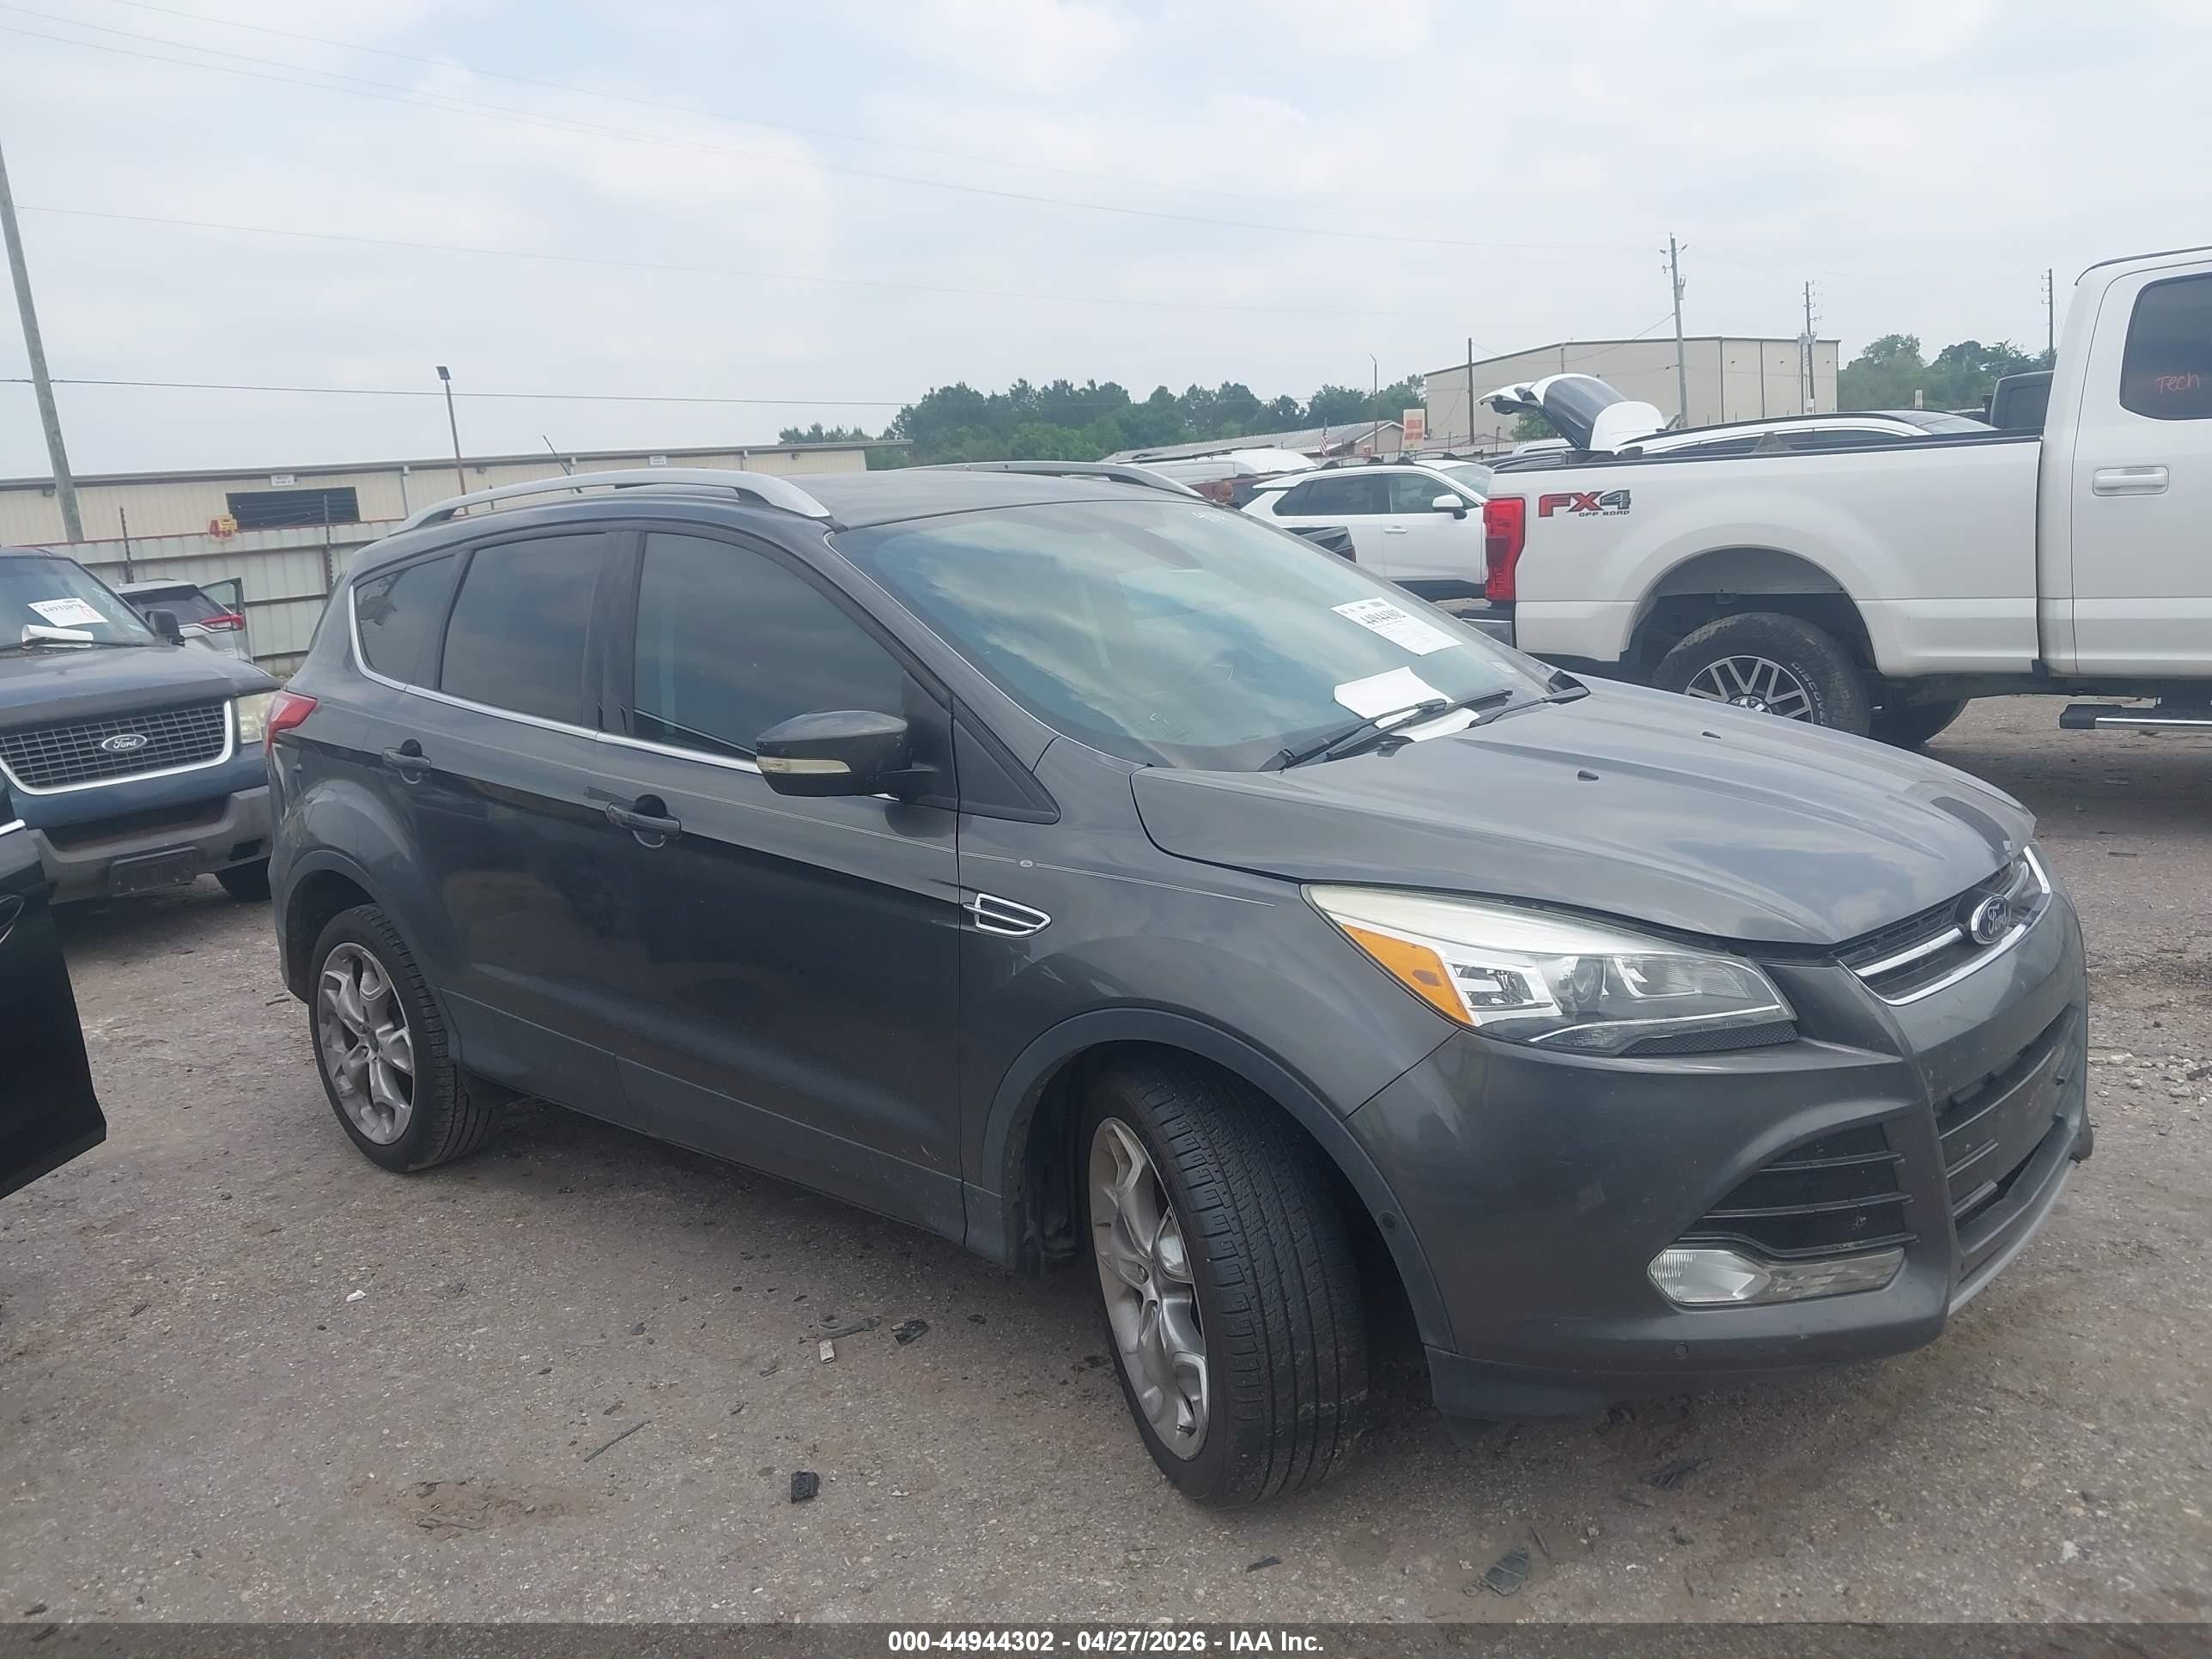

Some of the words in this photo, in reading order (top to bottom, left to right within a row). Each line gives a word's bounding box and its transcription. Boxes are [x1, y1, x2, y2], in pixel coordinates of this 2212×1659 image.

[1538, 489, 1631, 517] FX4
[112, 737, 137, 750] Ford
[1987, 902, 2008, 935] Ford
